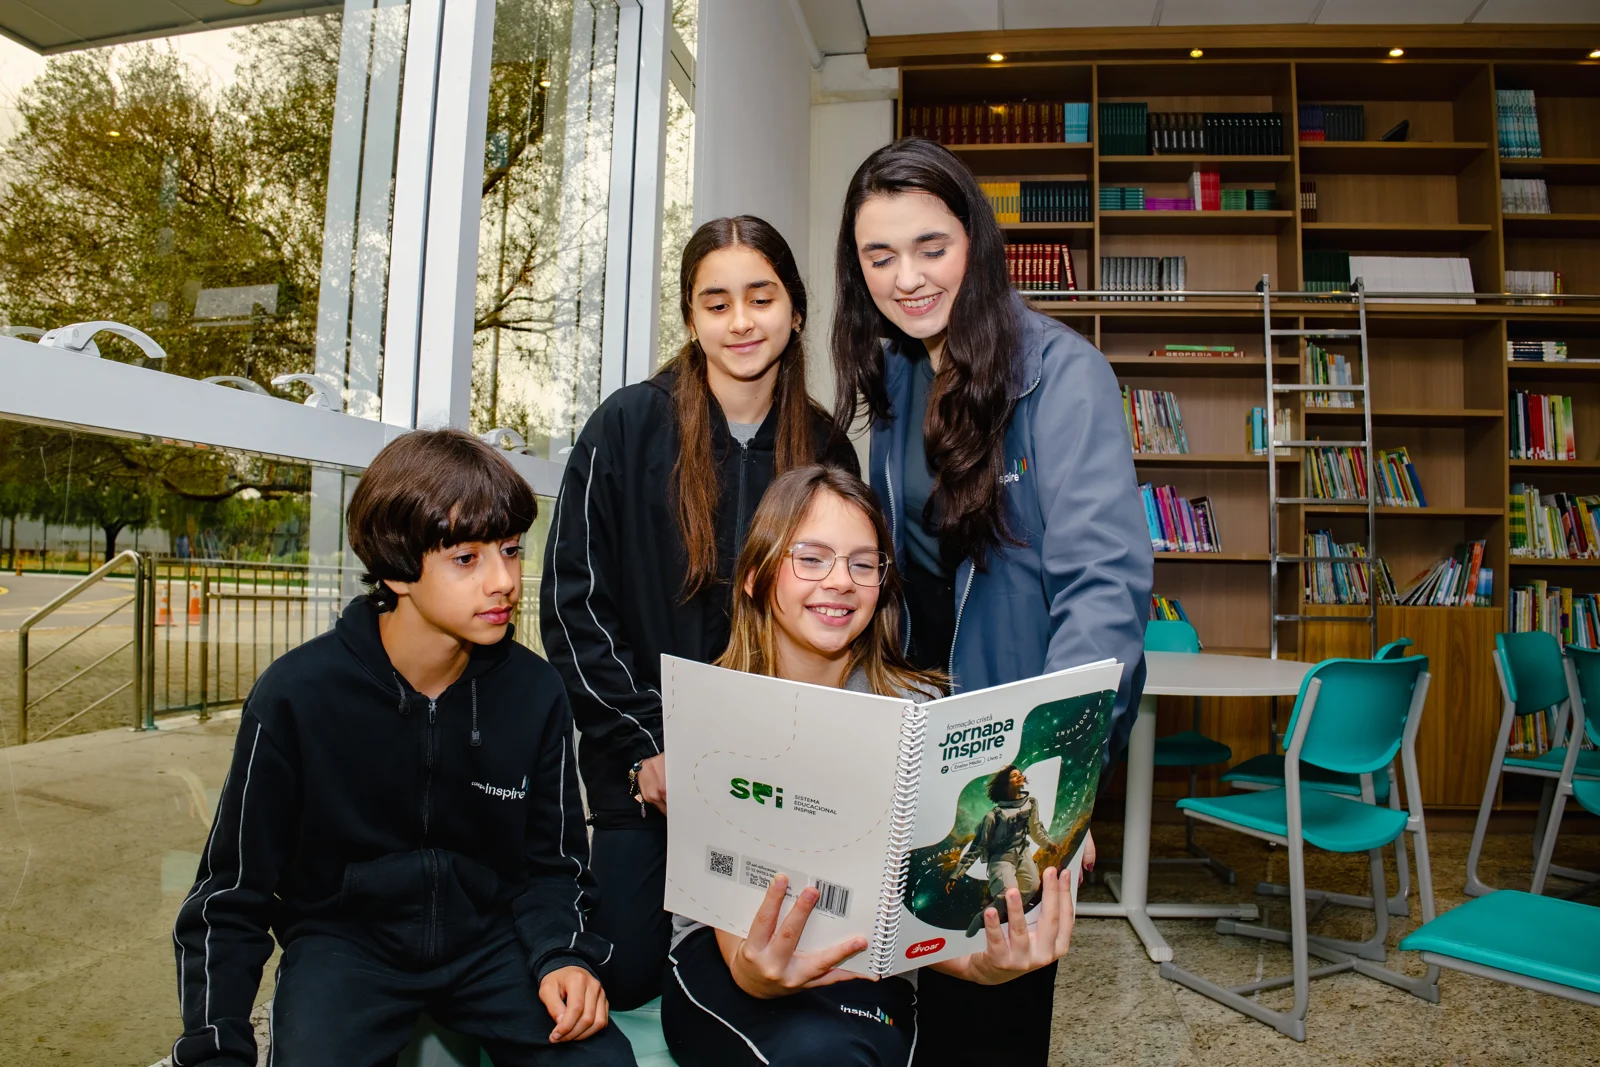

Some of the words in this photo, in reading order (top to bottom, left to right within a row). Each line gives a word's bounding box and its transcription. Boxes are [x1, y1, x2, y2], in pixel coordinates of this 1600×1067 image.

[998, 472, 1019, 486] spire
[946, 719, 975, 731] formação
[976, 714, 993, 725] cristã
[1056, 708, 1090, 737] ENVIADOS
[794, 794, 820, 805] SISTEMA
[793, 806, 817, 816] INSPIRE
[794, 800, 837, 815] EDUCACIONAL
[921, 846, 961, 866] CRIADOS
